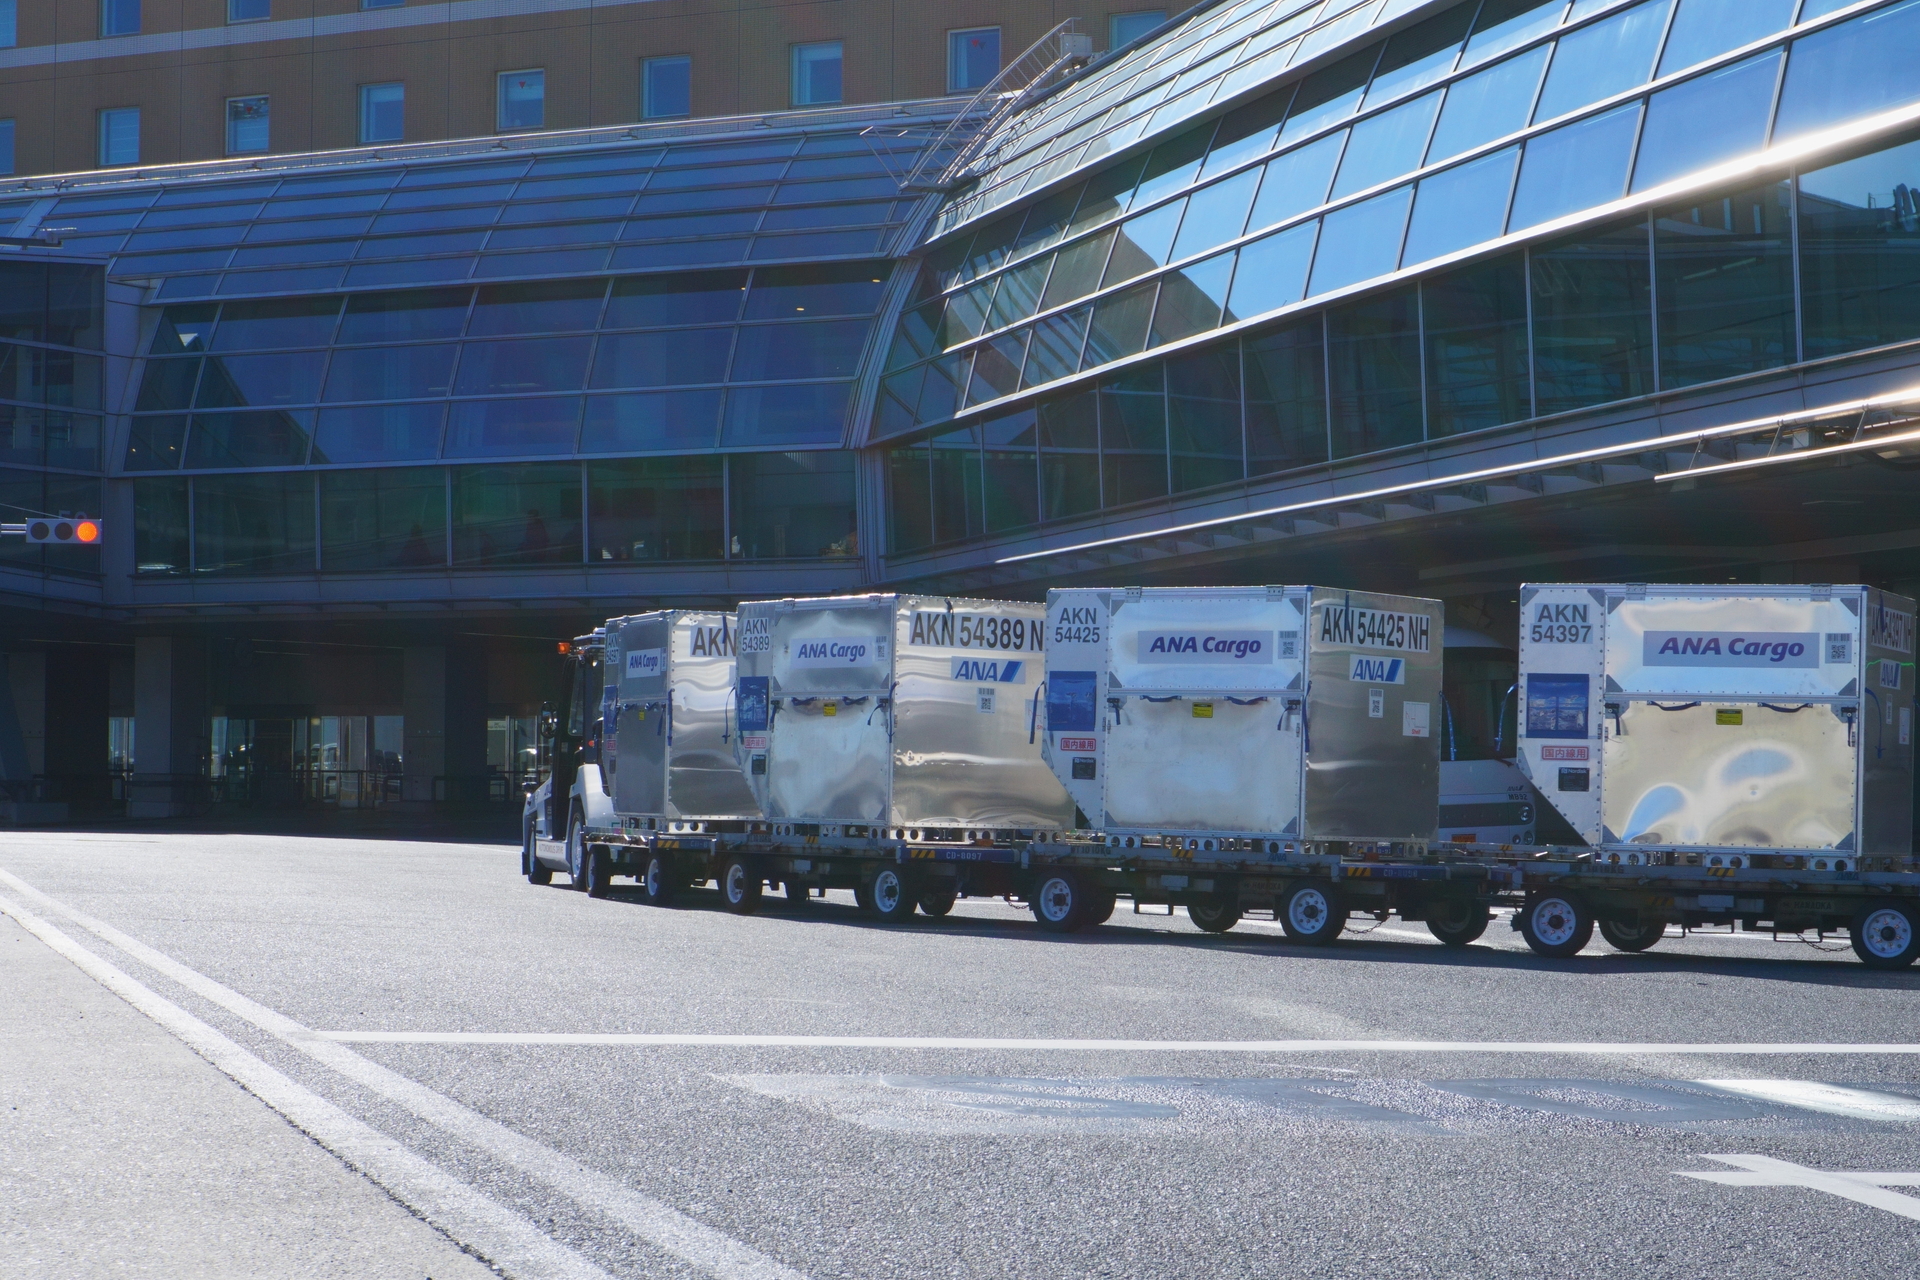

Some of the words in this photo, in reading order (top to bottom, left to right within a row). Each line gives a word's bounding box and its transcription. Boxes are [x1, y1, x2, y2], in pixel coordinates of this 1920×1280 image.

[1059, 607, 1097, 624] AKN
[1537, 604, 1588, 623] AKN
[744, 619, 768, 634] AKN
[911, 612, 955, 646] AKN
[959, 616, 1025, 650] 54389
[1055, 627, 1100, 643] 54425
[1321, 607, 1354, 643] AKN
[1357, 612, 1405, 648] 54425
[1409, 615, 1429, 650] NH
[1531, 624, 1592, 643] 54397
[742, 636, 770, 652] 54389
[798, 643, 828, 658] ANA
[830, 642, 866, 662] Cargo
[1150, 636, 1198, 653] ANA
[1202, 636, 1262, 658] Cargo
[1658, 637, 1722, 655] ANA
[1728, 637, 1805, 662] Cargo
[629, 655, 642, 669] ANA
[643, 655, 659, 671] Cargo
[955, 660, 998, 682] ANA
[1352, 658, 1385, 681] ANA
[1063, 739, 1094, 749] 国内線用
[1544, 748, 1587, 758] 国内線用
[945, 851, 983, 861] CD-8097
